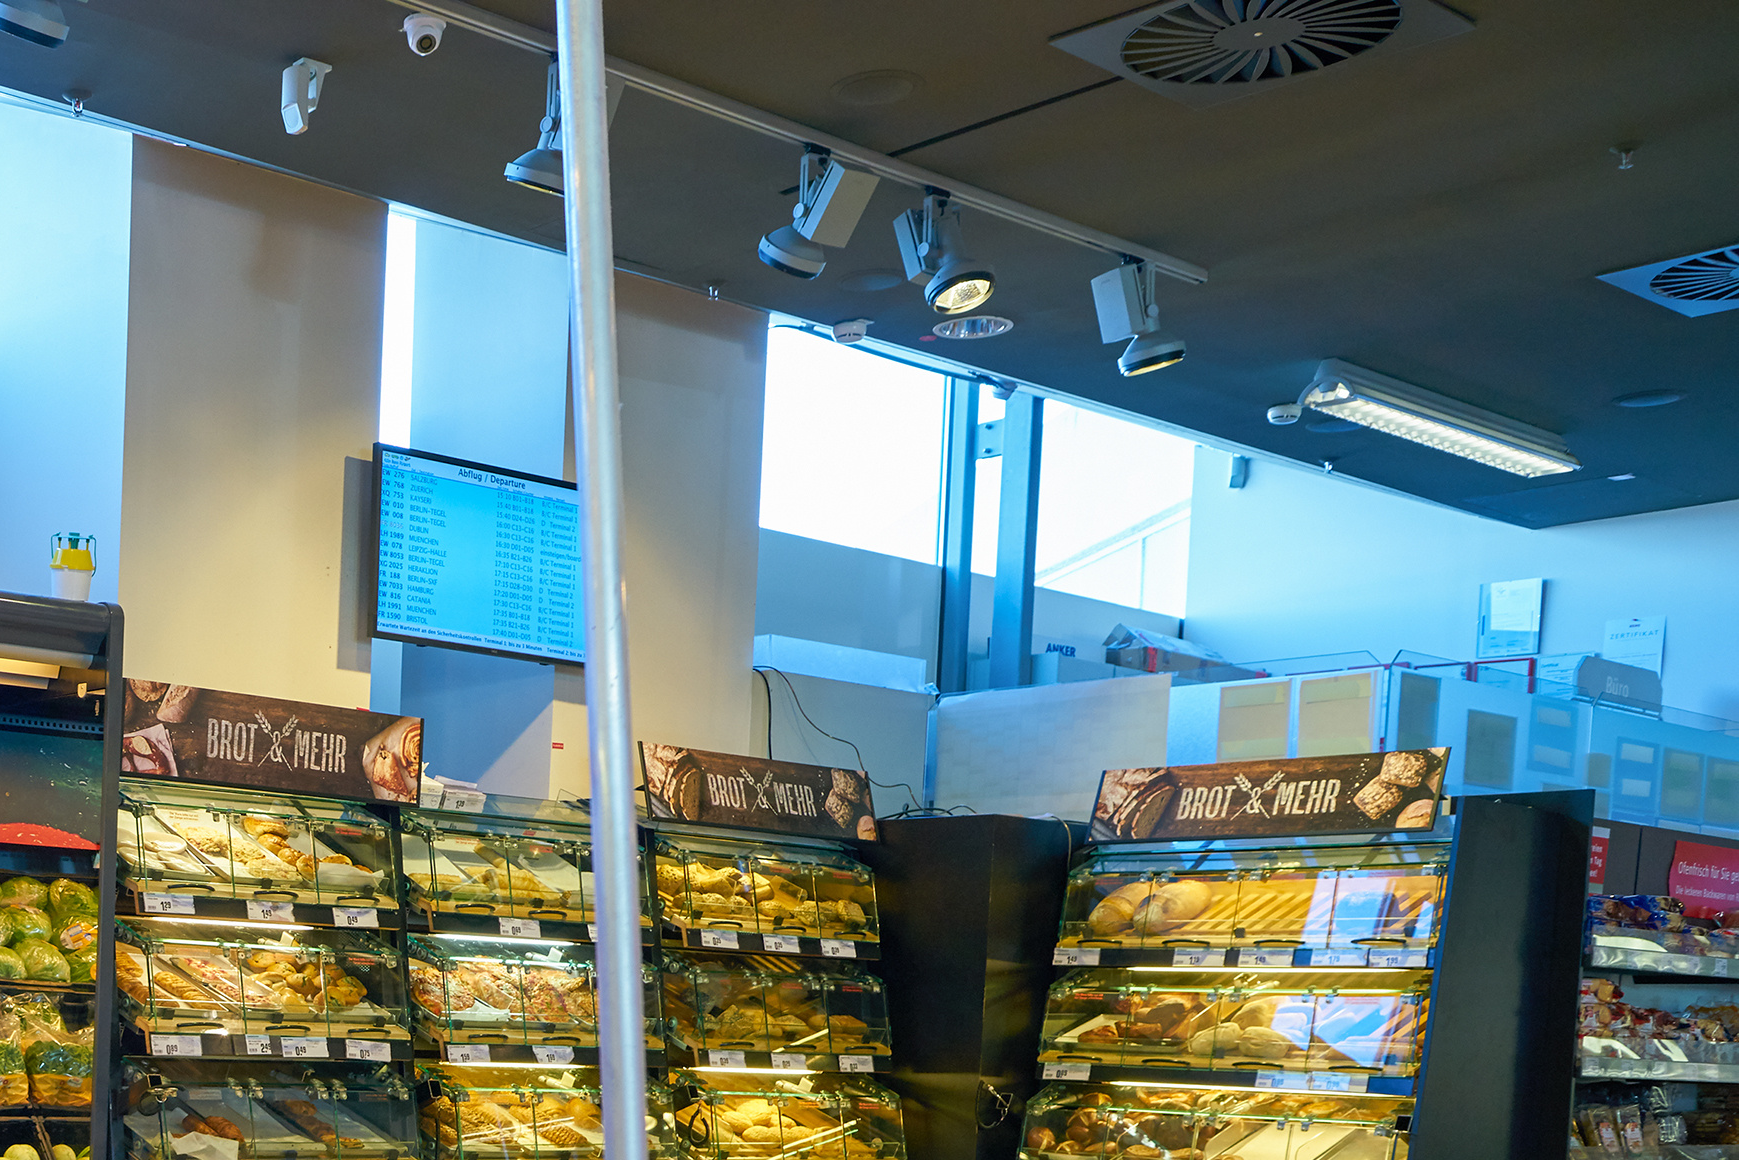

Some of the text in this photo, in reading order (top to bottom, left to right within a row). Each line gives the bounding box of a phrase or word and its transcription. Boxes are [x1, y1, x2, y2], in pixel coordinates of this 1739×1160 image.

[411, 475, 437, 485] SALZBURG
[458, 468, 483, 482] Abflug
[490, 475, 526, 489] Departure
[410, 485, 433, 494] ZUERICH
[410, 505, 446, 518] BERLIN-TEGEL
[410, 515, 446, 528] BERLIN-TEGEL
[409, 525, 429, 534] DUBLIN
[408, 555, 445, 567] BERLIN-TEGEL
[407, 585, 434, 595] HAMBURG
[407, 595, 432, 605] CATANIA
[406, 615, 428, 624] BRISTOL
[1609, 629, 1659, 640] ZERTIFIKAT
[1046, 643, 1076, 658] ANKER
[1606, 676, 1630, 698] Büro
[206, 717, 348, 774] BROT & MEHR
[708, 772, 816, 818] BROT & MEHR
[1177, 777, 1341, 820] BROT & MEHR
[1678, 861, 1730, 880] Ofenfrisch für Sie
[161, 902, 172, 911] 1.29
